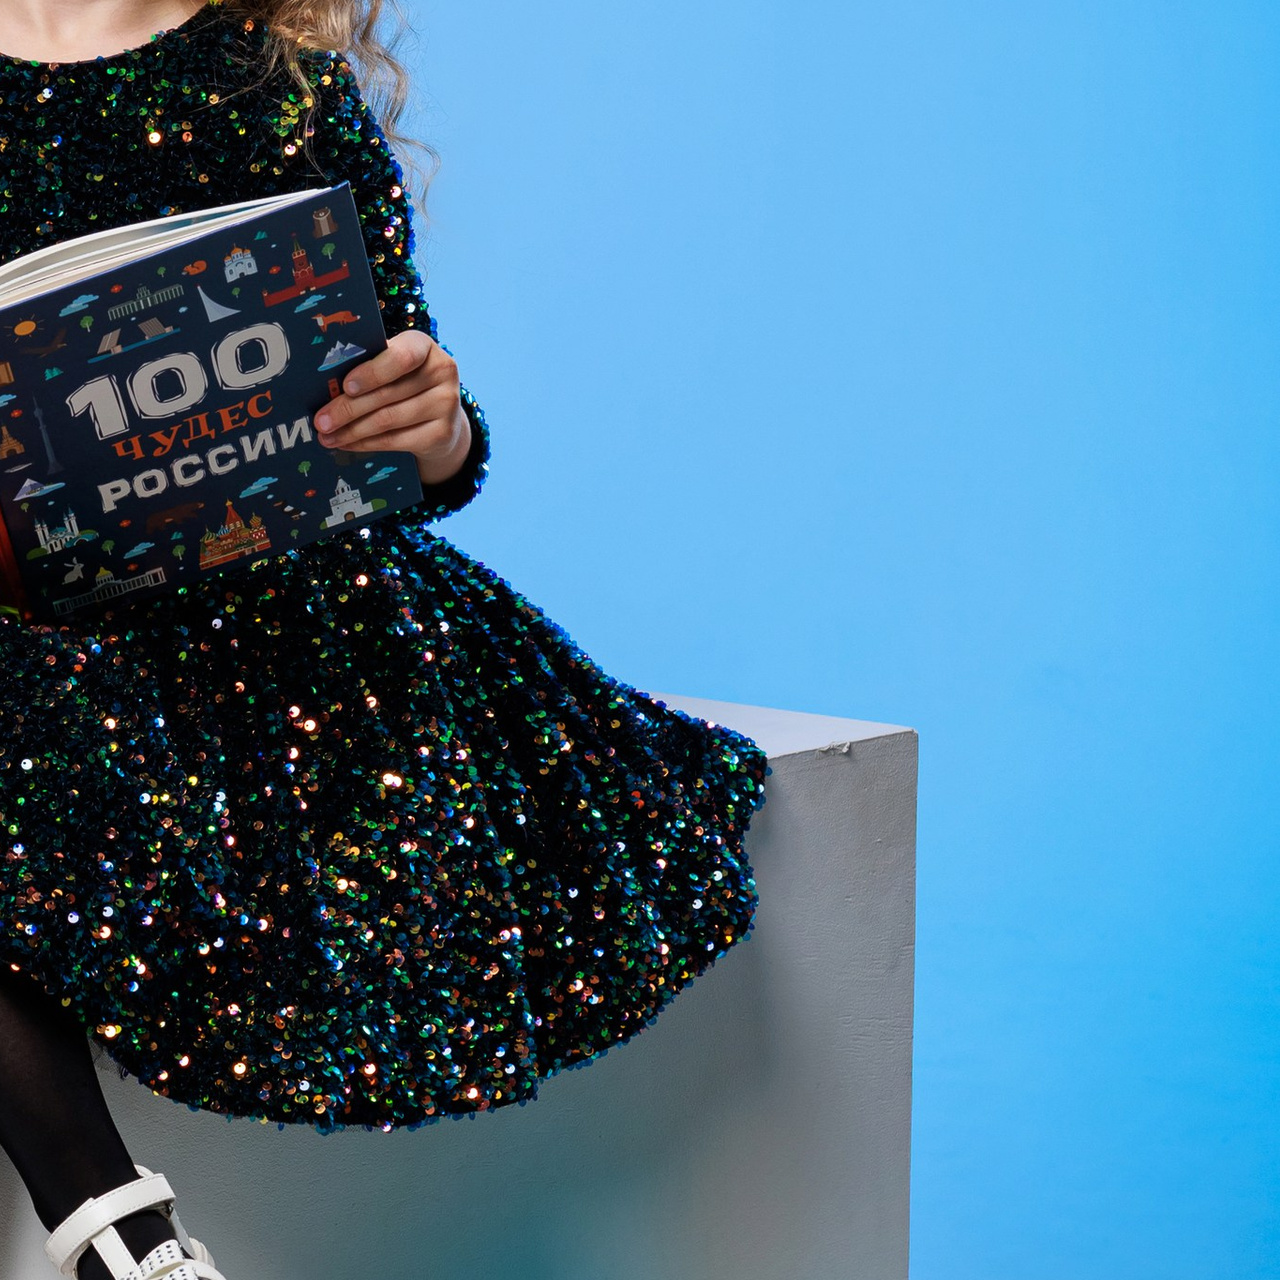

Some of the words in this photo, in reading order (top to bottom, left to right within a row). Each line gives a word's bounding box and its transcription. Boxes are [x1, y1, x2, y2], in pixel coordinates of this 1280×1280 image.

[66, 322, 291, 441] 100
[111, 390, 274, 460] ЧУДЕС
[97, 416, 313, 514] РОССИИ
